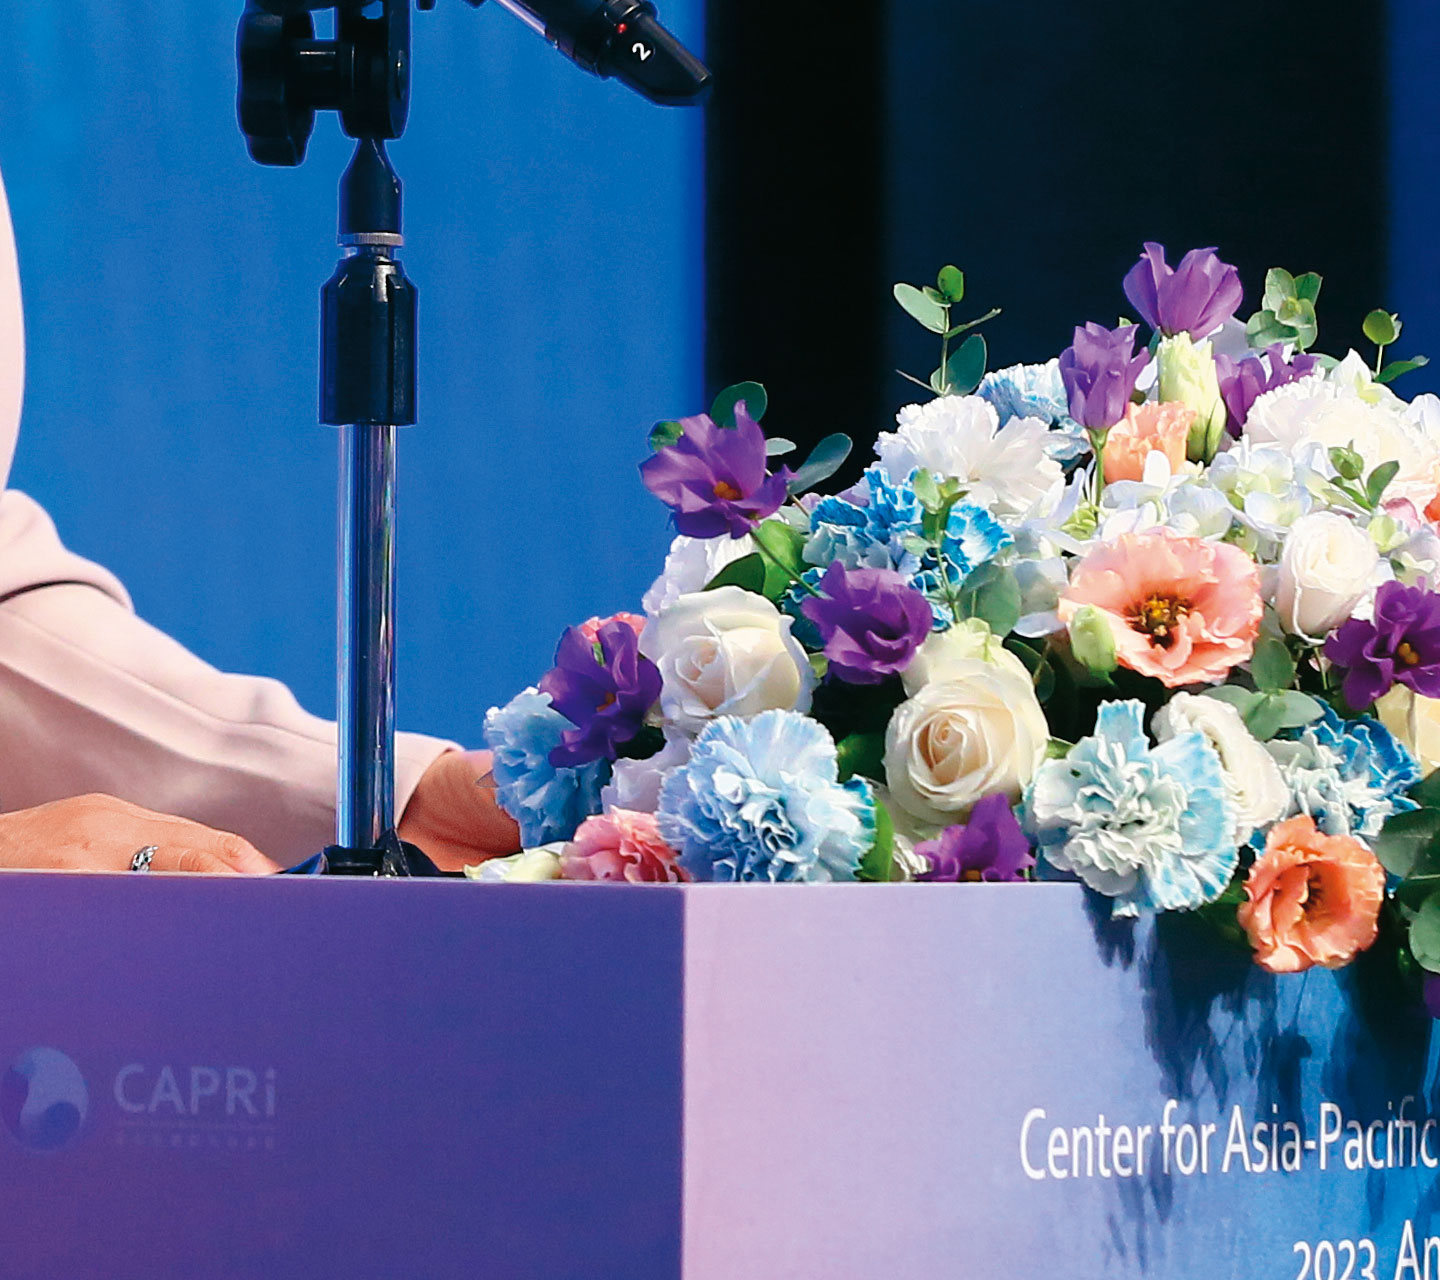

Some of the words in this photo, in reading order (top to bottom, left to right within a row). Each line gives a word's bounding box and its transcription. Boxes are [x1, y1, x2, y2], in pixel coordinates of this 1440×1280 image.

[632, 42, 651, 61] 2
[1020, 1107, 1151, 1179] Center
[1160, 1099, 1216, 1175] for
[1221, 1095, 1438, 1175] Asia-Pacific
